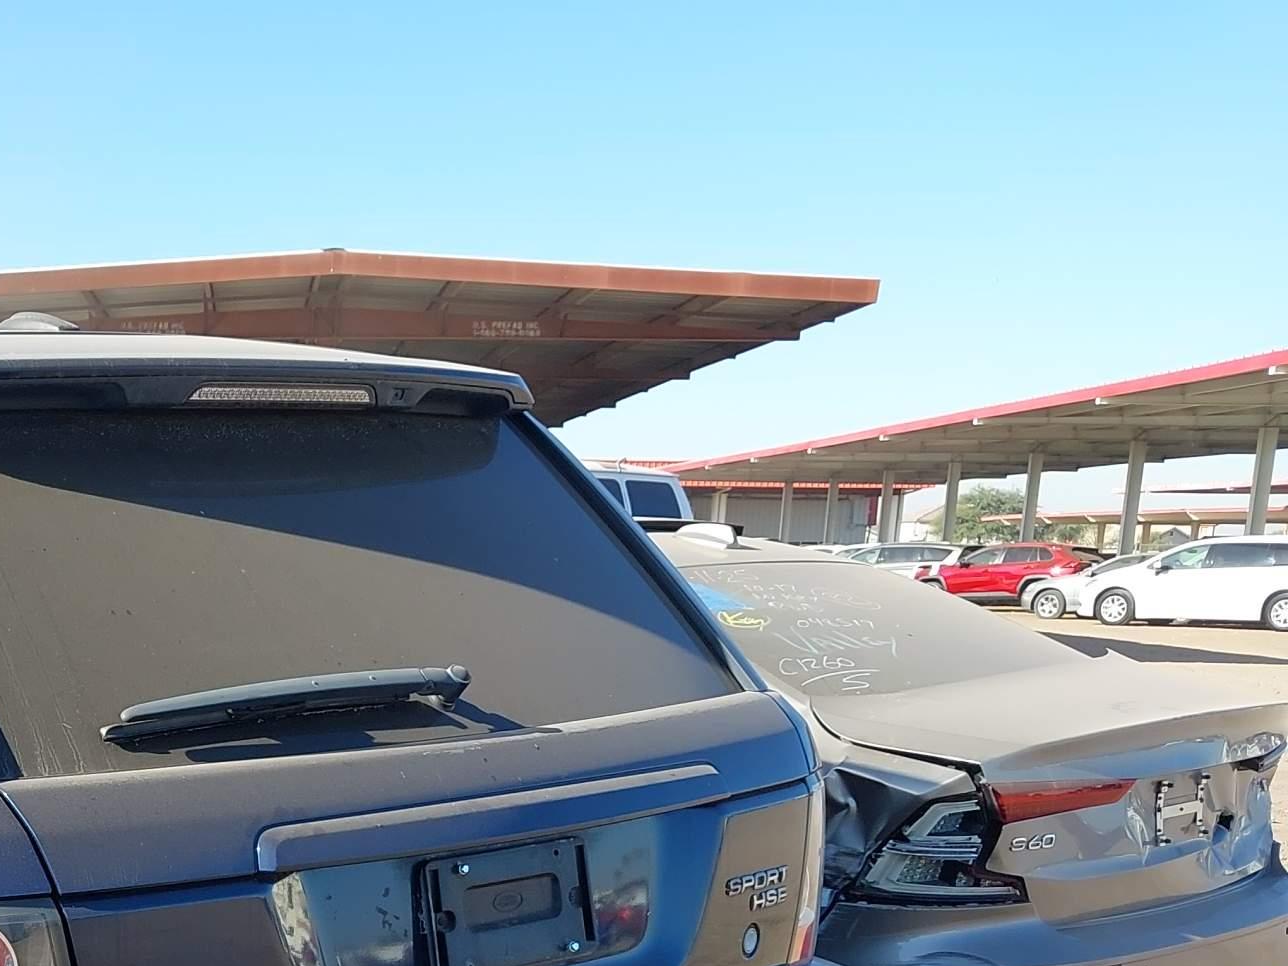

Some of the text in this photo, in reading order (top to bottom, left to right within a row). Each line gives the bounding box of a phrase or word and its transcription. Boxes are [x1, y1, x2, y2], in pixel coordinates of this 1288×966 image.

[1010, 833, 1057, 852] S60
[726, 865, 789, 897] SPORT
[750, 886, 789, 911] HSE
